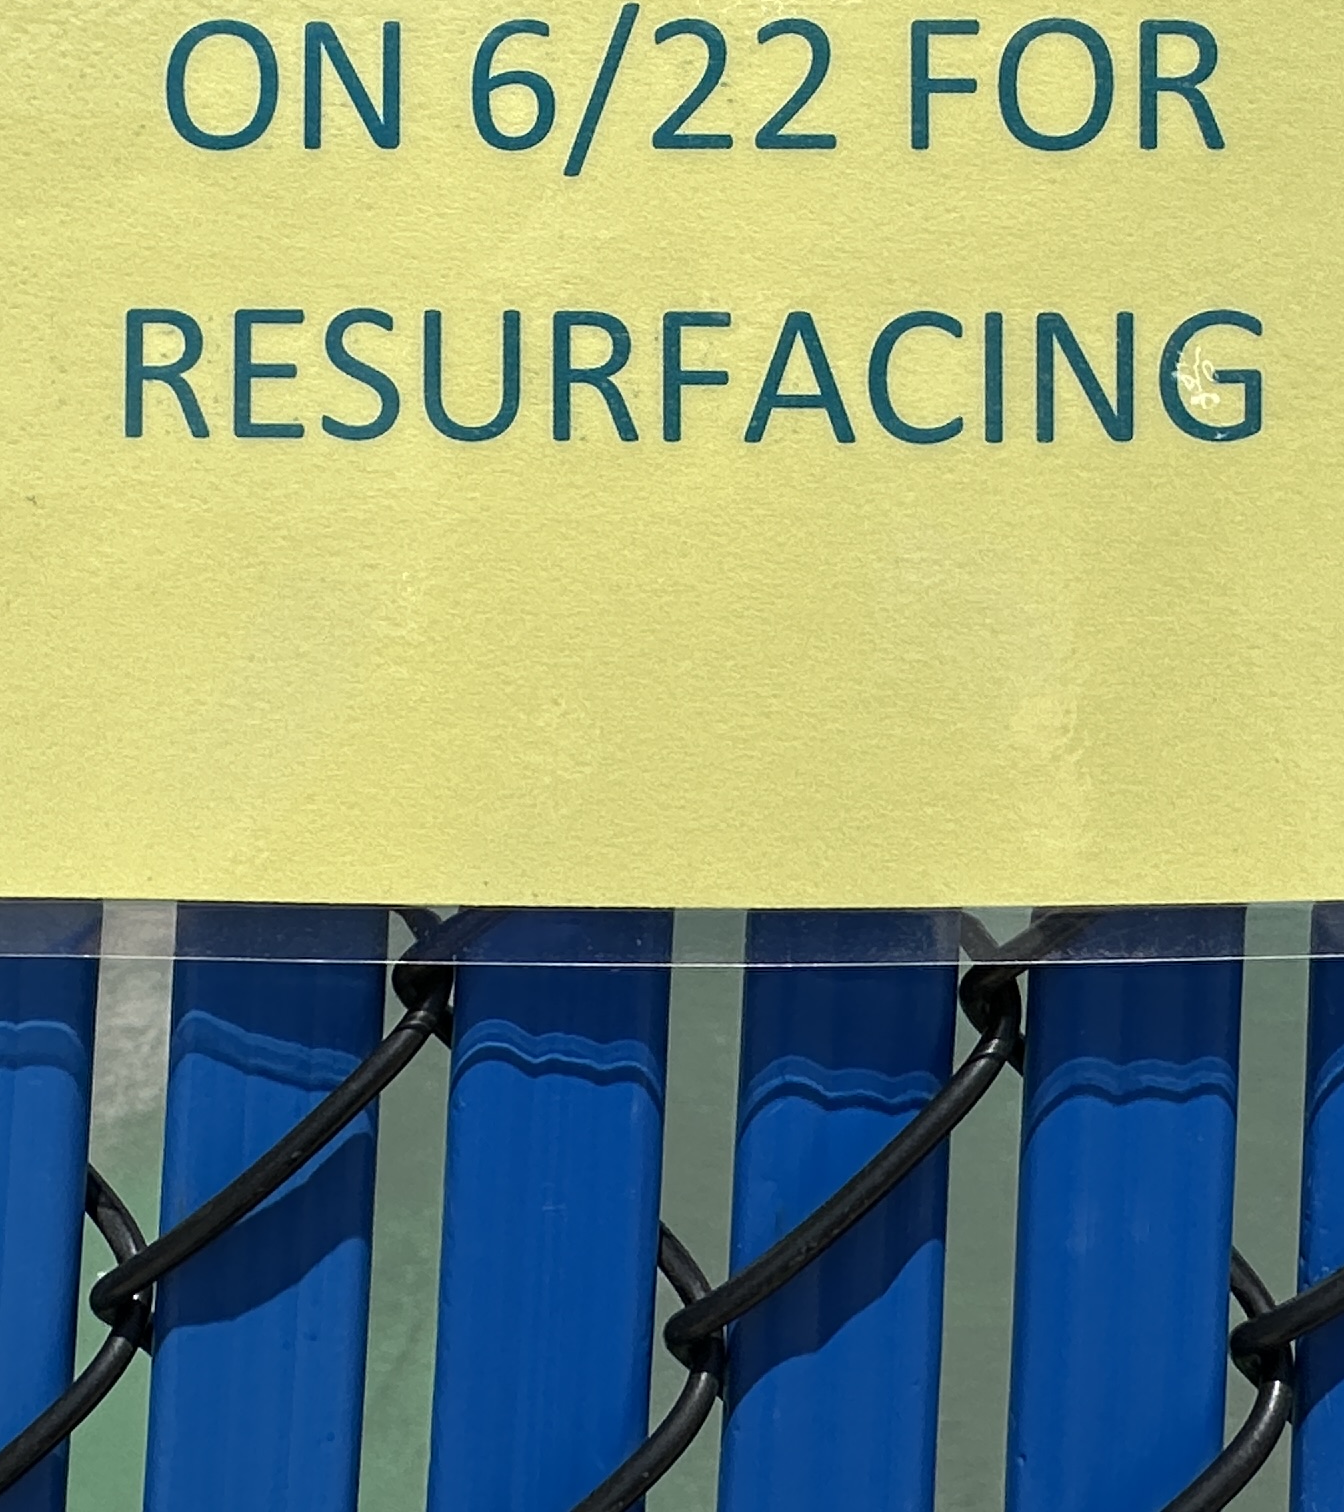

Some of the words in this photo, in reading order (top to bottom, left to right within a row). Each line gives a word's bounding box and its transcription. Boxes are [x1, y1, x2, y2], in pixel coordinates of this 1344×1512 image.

[166, 19, 401, 151] ON
[472, 3, 837, 177] 6/22
[911, 17, 1225, 151] FOR
[125, 308, 1263, 443] RESURFACING
